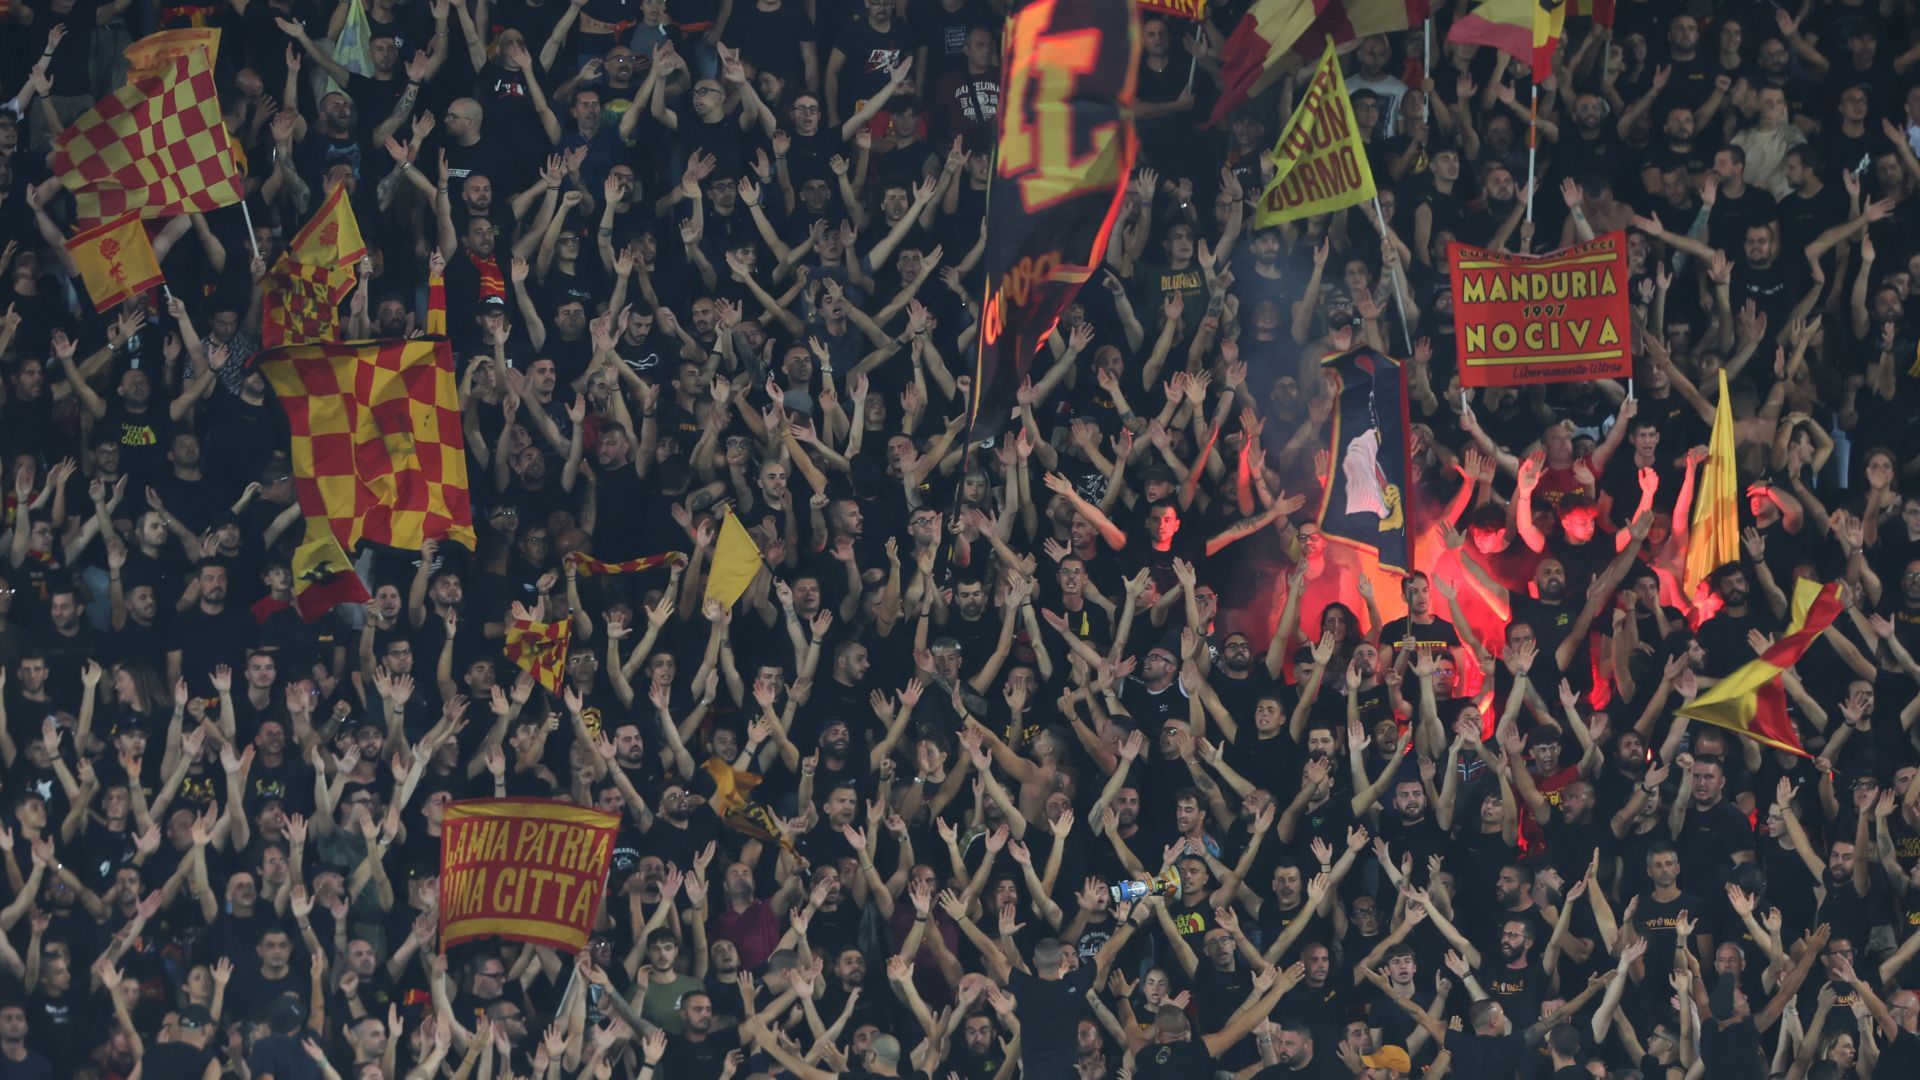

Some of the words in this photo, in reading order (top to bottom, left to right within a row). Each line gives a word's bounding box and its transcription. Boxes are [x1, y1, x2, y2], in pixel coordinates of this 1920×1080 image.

[1463, 267, 1617, 304] MANDURIA
[1523, 304, 1566, 319] 1997
[1465, 316, 1619, 353] NOCIVA
[514, 820, 609, 877] PATRIA
